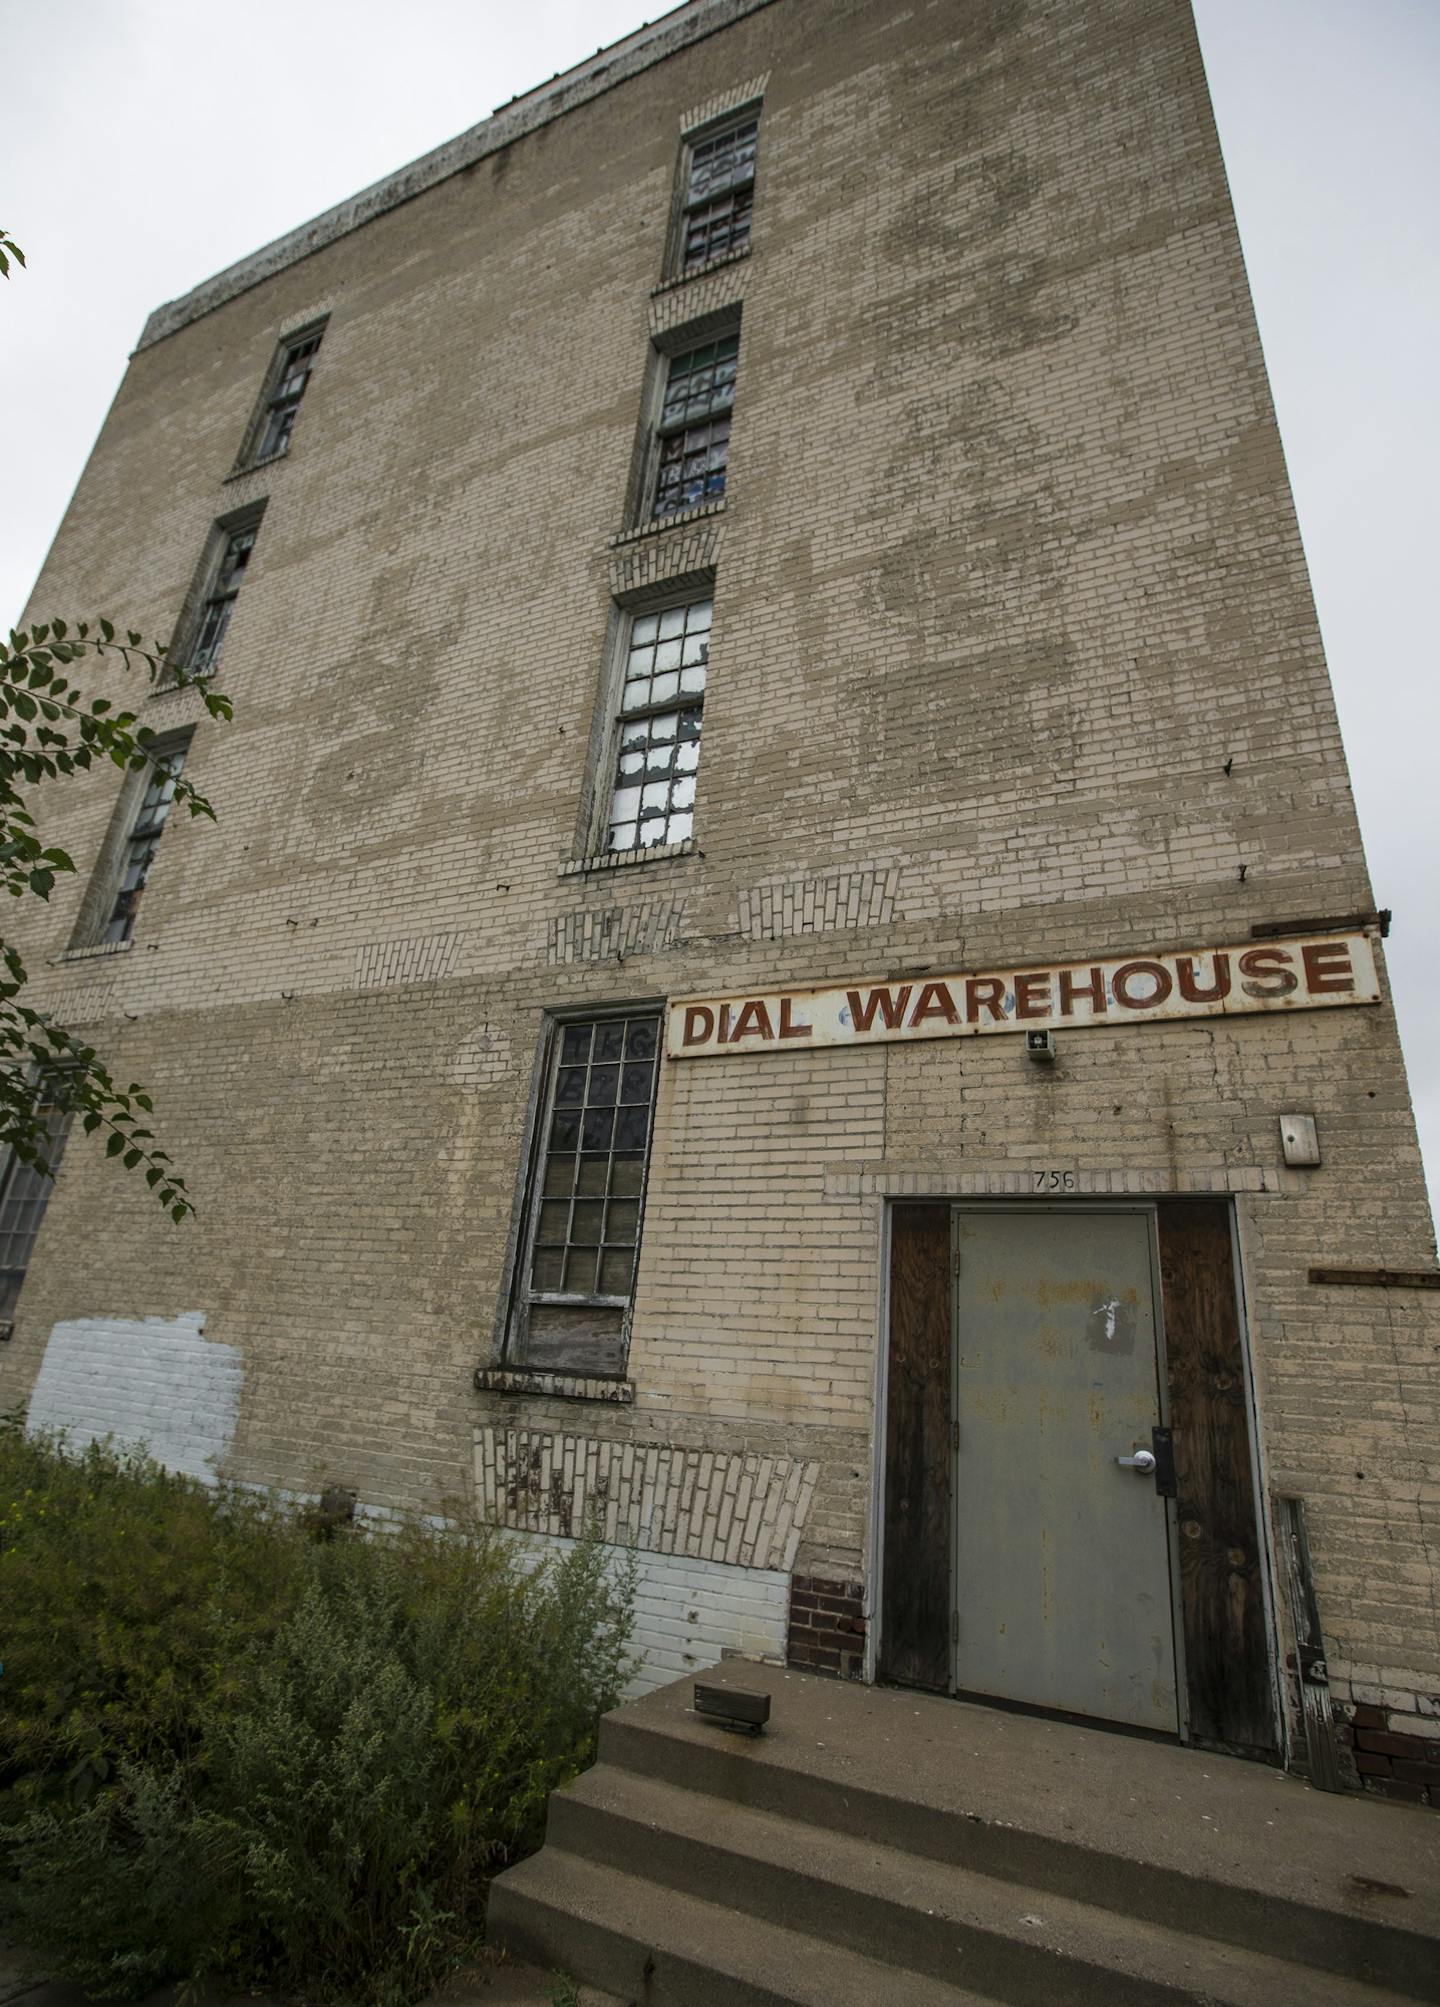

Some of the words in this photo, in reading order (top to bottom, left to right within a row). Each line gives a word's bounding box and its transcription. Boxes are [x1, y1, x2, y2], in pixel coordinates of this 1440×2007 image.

[682, 997, 813, 1048] DIAL
[846, 941, 1355, 1032] WAREHOUSE
[1034, 1170, 1075, 1189] 756
